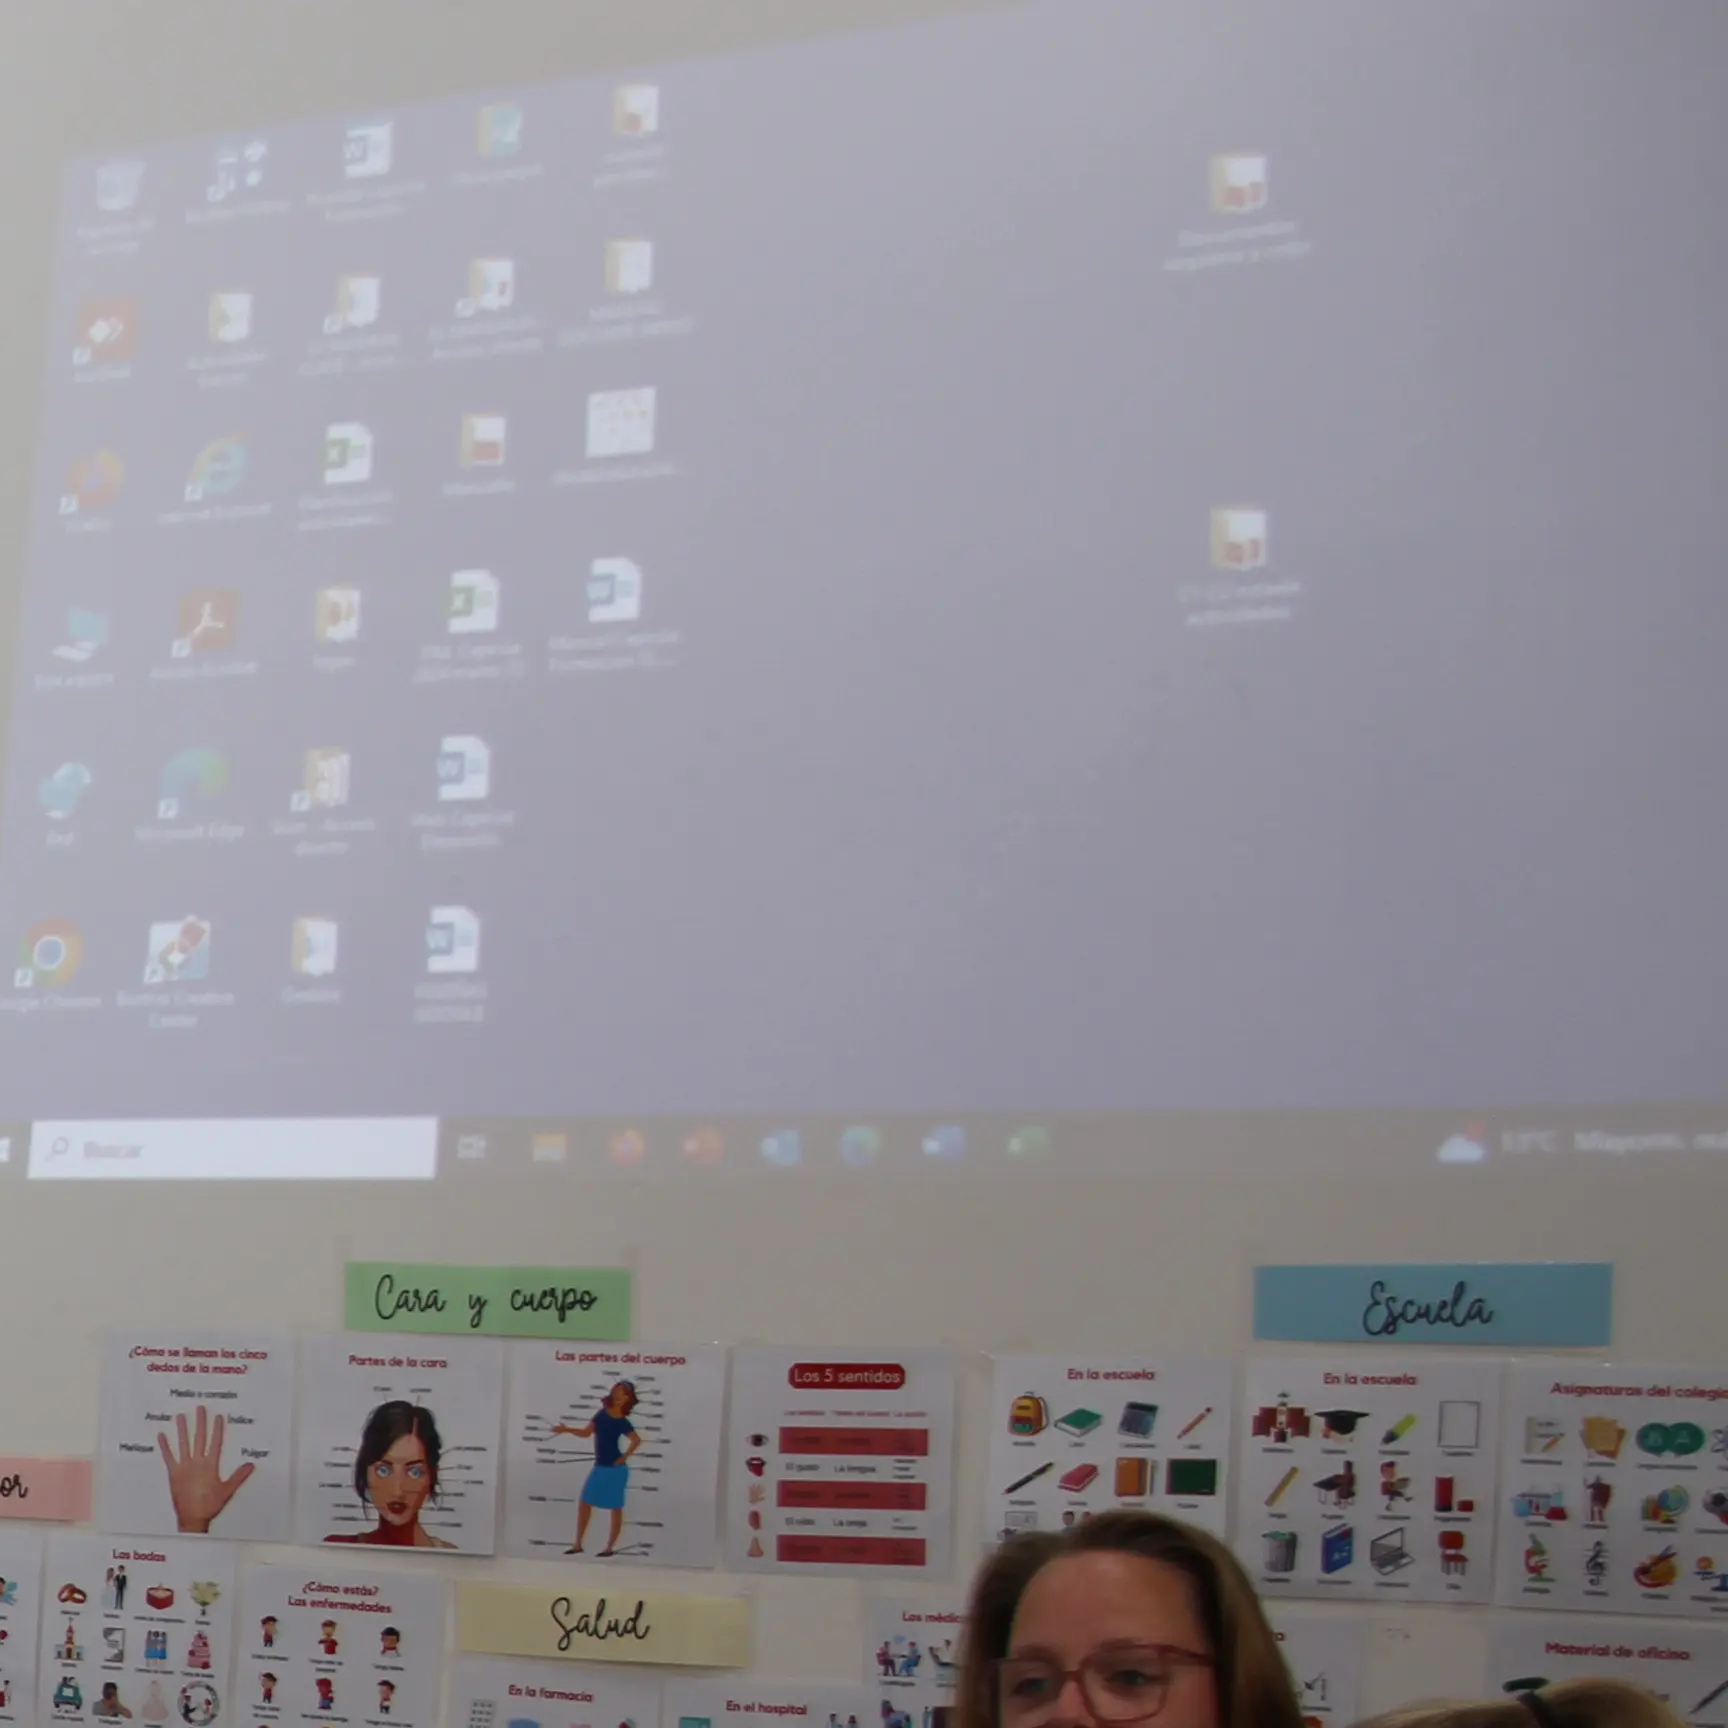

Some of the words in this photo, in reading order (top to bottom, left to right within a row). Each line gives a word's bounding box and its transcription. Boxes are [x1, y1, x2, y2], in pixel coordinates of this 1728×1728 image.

[374, 1274, 446, 1320] Cara
[468, 1291, 488, 1328] y
[510, 1286, 598, 1323] cuerpo
[1363, 1280, 1494, 1337] Escuela
[130, 1346, 166, 1358] ¿Cómo
[168, 1348, 180, 1358] se
[182, 1348, 218, 1358] llaman
[220, 1348, 236, 1359] los
[238, 1350, 267, 1360] cinco
[555, 1351, 576, 1363] Las
[578, 1352, 618, 1366] partes
[620, 1352, 642, 1365] del
[642, 1356, 687, 1368] cuerpo
[147, 1362, 180, 1373] dedos
[182, 1363, 196, 1373] de
[198, 1364, 210, 1374] la
[212, 1364, 248, 1374] mano?
[348, 1354, 386, 1368] Partes
[388, 1356, 404, 1367] de
[404, 1356, 418, 1368] la
[420, 1358, 448, 1368] cara
[794, 1368, 820, 1382] Los
[824, 1369, 834, 1382] 5
[838, 1369, 900, 1383] sentidos
[1068, 1368, 1084, 1380] En
[1086, 1370, 1100, 1381] la
[1102, 1370, 1156, 1382] escuela
[1322, 1372, 1341, 1387] En
[1345, 1372, 1358, 1386] la
[1360, 1374, 1417, 1386] escuela
[1552, 1383, 1642, 1398] Asignaturas
[1646, 1385, 1670, 1398] del
[241, 1448, 270, 1459] Pulgar
[114, 1550, 130, 1560] Las
[132, 1552, 166, 1563] bodas
[302, 1583, 338, 1594] ¿Cómo
[342, 1586, 378, 1596] estás?
[288, 1598, 306, 1606] Las
[310, 1599, 392, 1613] enfermedades
[550, 1596, 650, 1651] Salud
[1544, 1641, 1610, 1658] Material
[1612, 1645, 1634, 1659] de
[1638, 1646, 1690, 1661] oficina
[508, 1685, 522, 1698] En
[524, 1686, 536, 1698] la
[538, 1688, 594, 1703] farmacia
[726, 1700, 740, 1714] En
[742, 1702, 754, 1713] el
[756, 1704, 808, 1717] hospital
